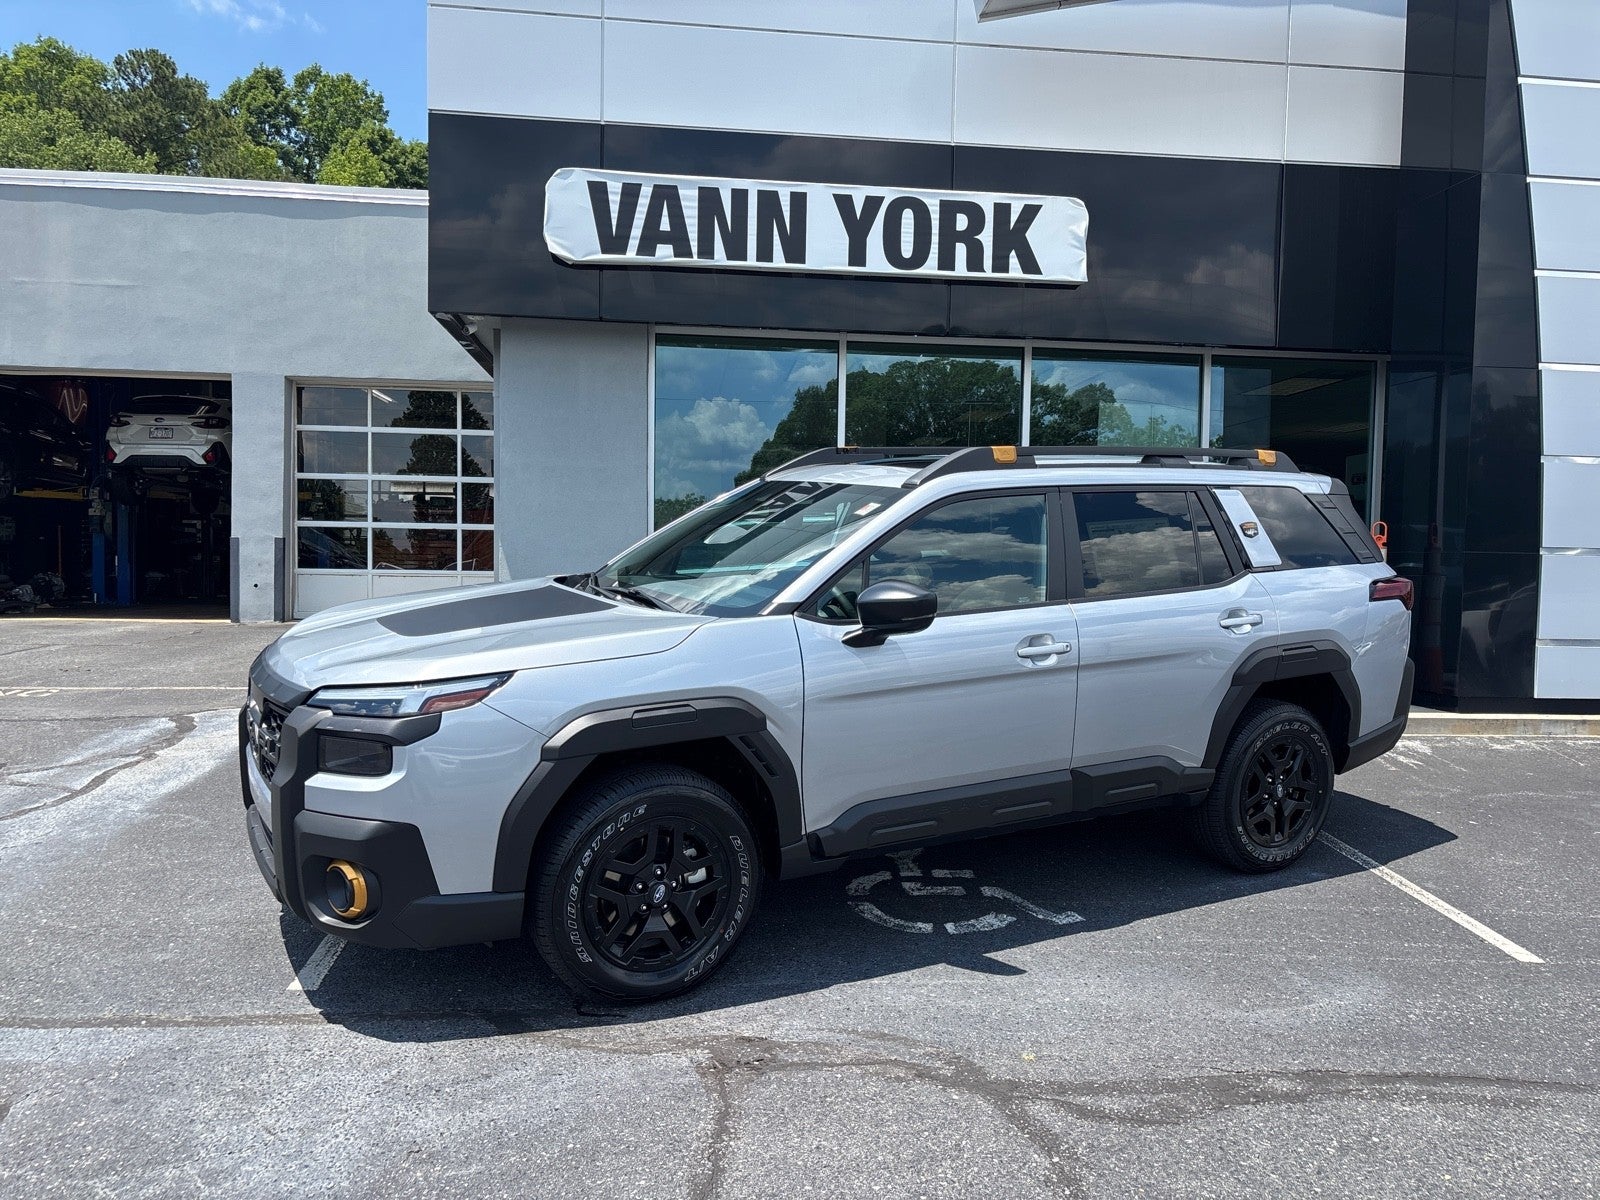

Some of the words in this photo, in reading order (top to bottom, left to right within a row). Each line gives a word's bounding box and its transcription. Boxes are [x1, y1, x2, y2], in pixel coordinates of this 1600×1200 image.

[587, 181, 807, 264] VANN
[833, 194, 1043, 275] YORK
[1254, 722, 1310, 751] DUELER
[567, 804, 647, 963] BRIDGESTONE
[725, 835, 750, 942] DUELER
[684, 945, 719, 982] A/T
